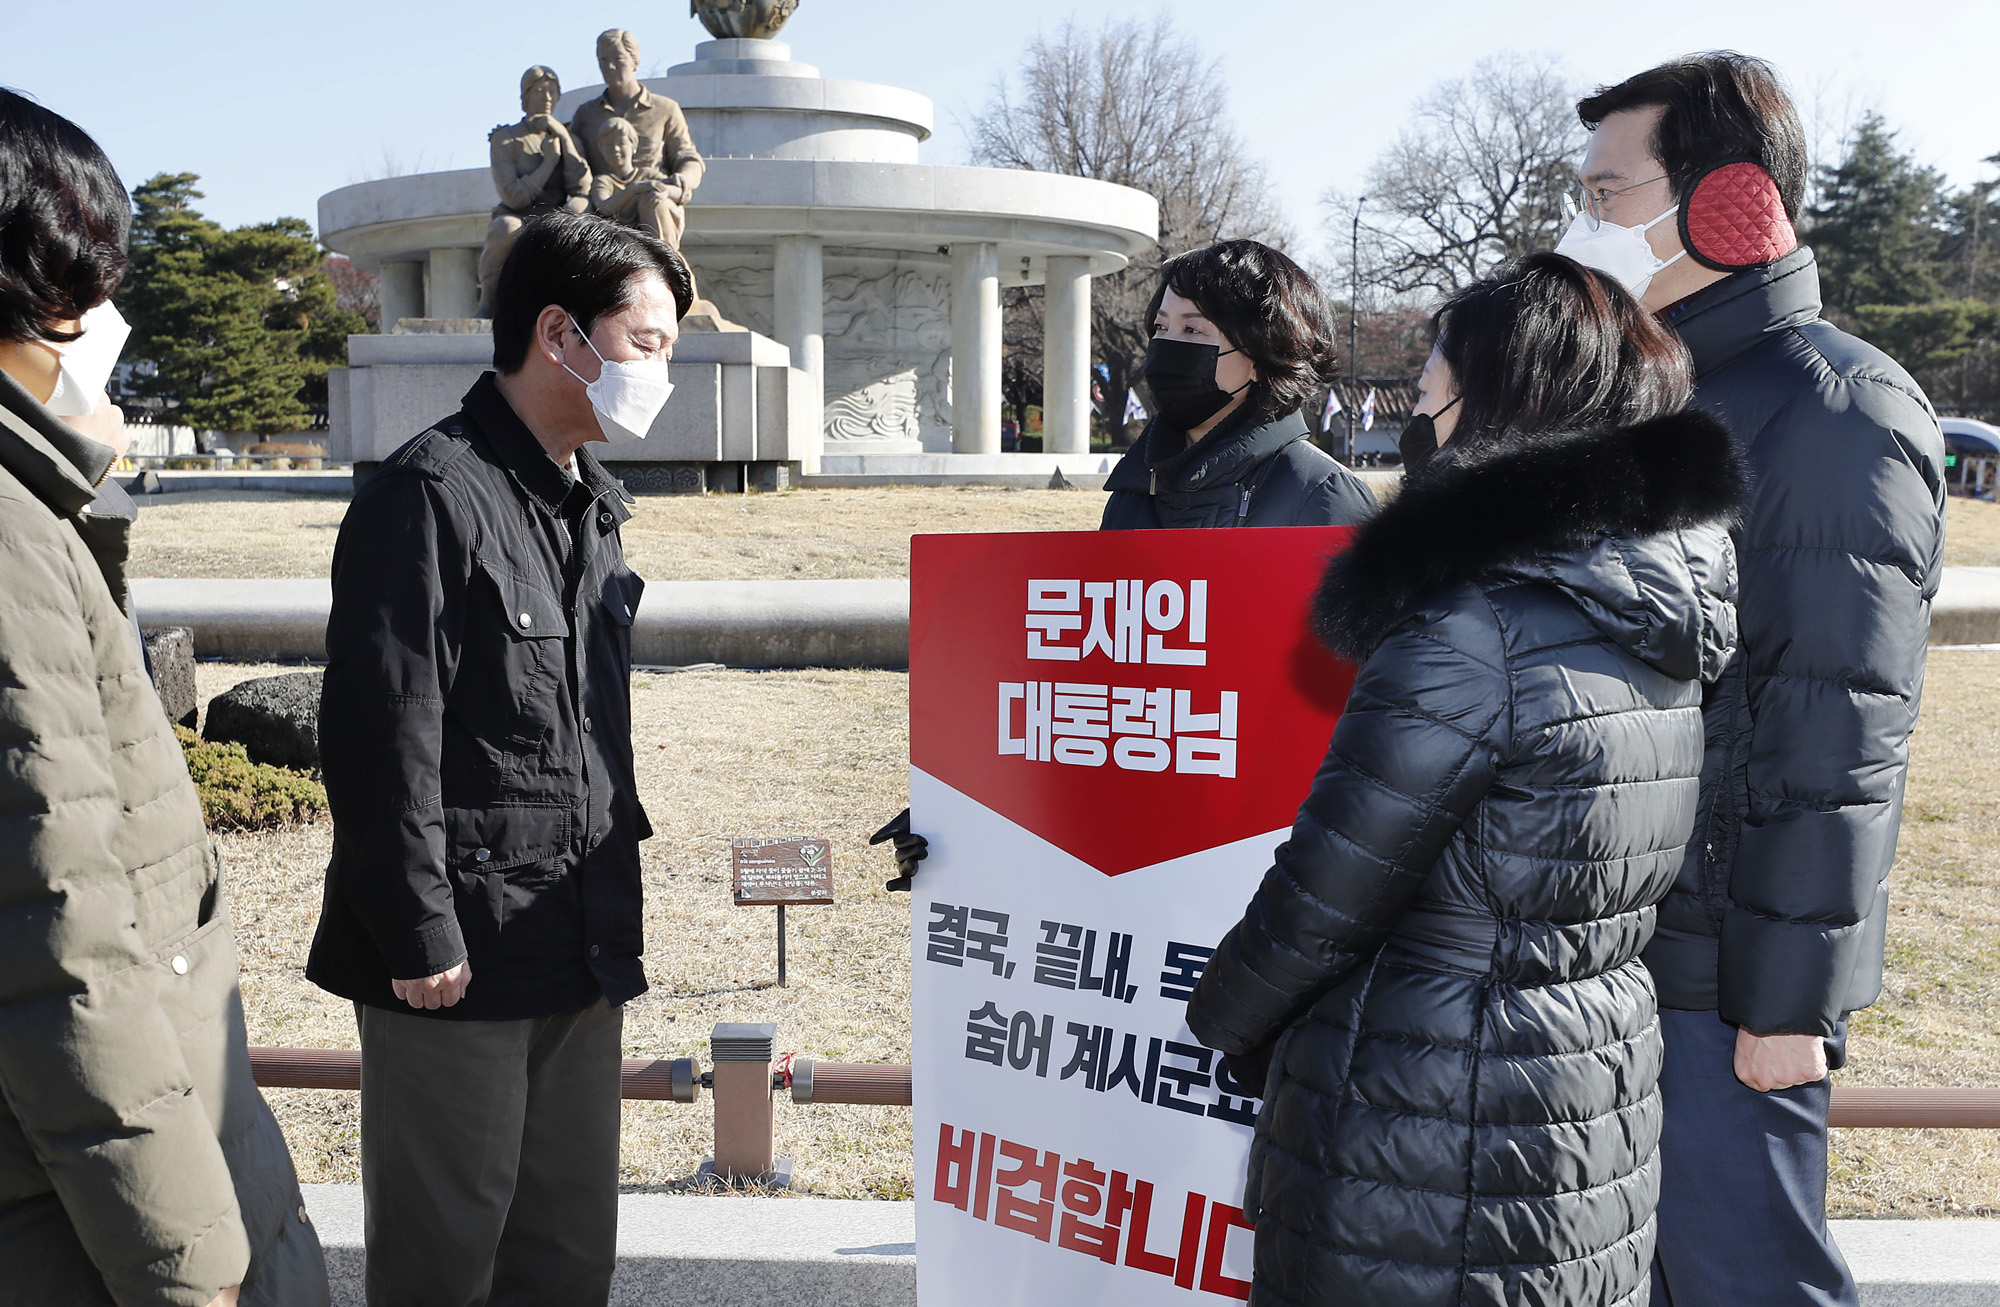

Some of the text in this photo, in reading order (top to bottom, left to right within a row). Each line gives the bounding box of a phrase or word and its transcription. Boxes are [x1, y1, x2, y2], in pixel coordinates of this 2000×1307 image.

[1025, 579, 1208, 667] 문재인
[998, 680, 1239, 779] 대통령님
[926, 902, 1017, 980] 결국,
[1033, 919, 1139, 1004] 끝내,
[965, 1000, 1264, 1128] 숨어 계시군요
